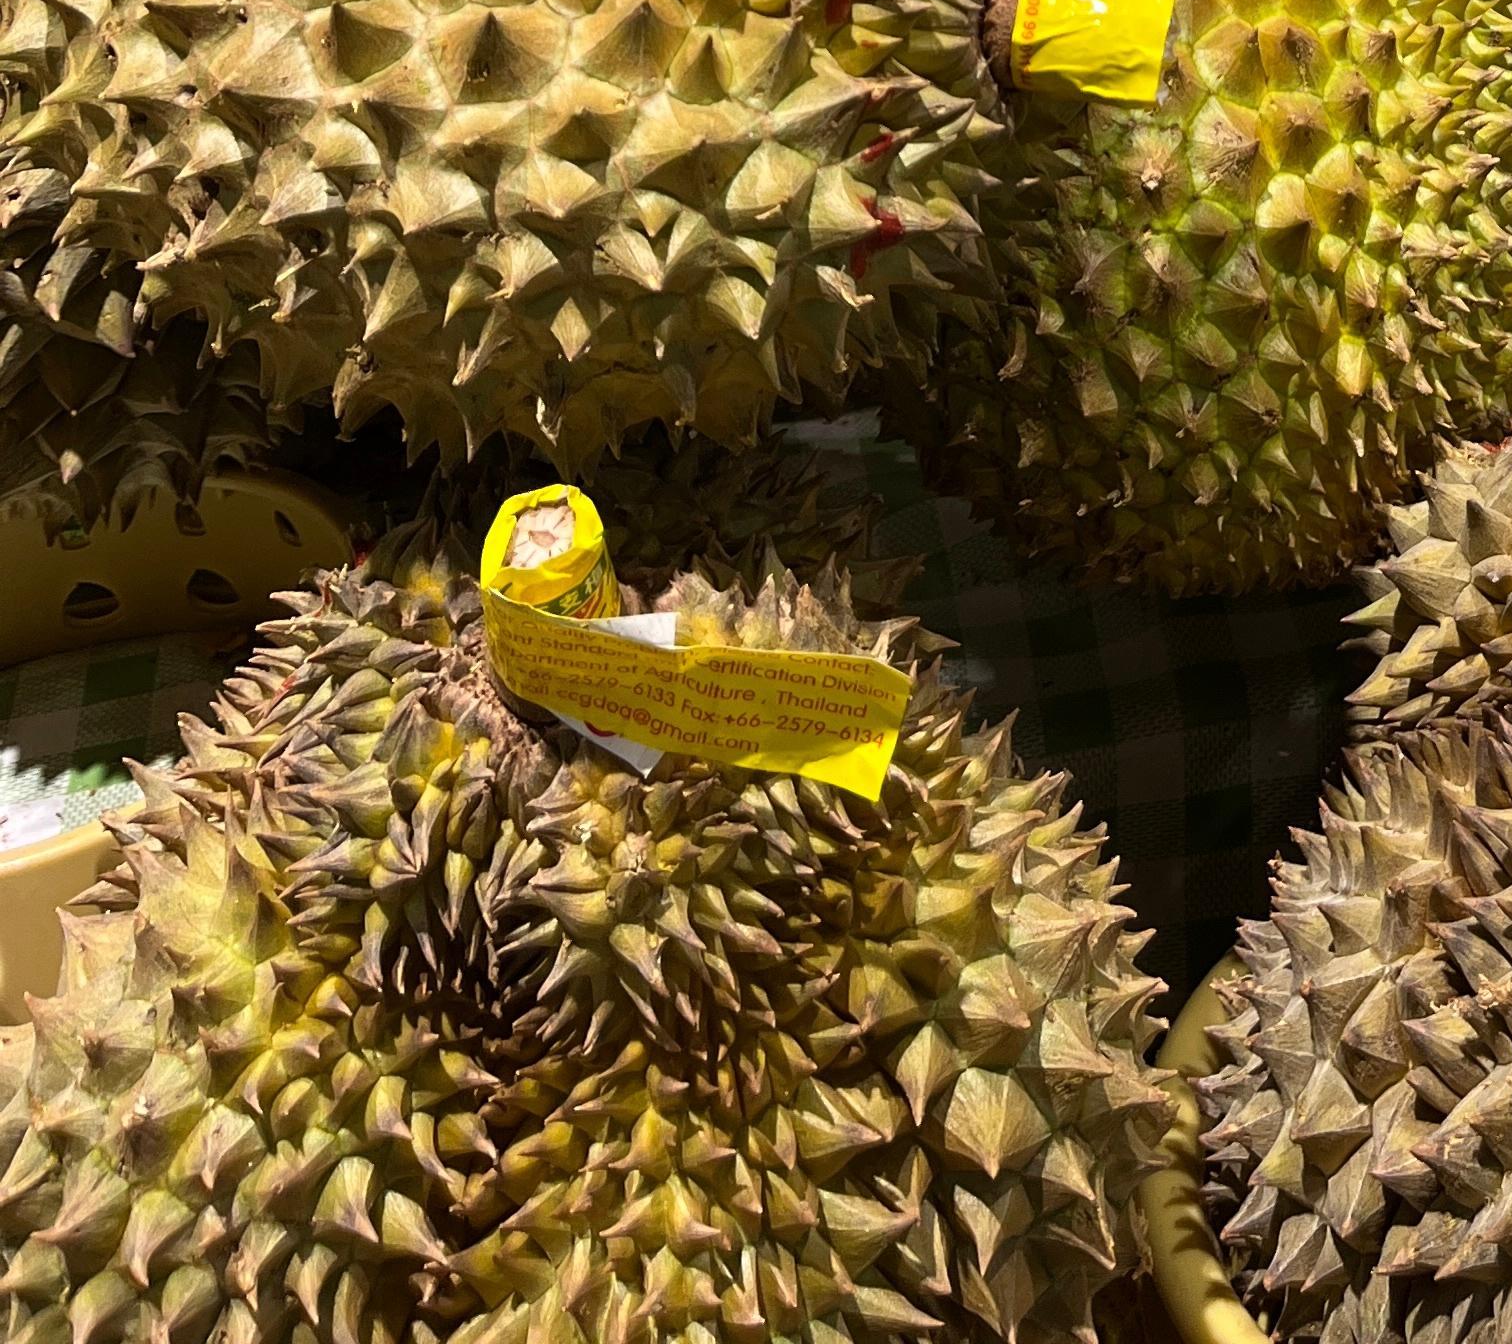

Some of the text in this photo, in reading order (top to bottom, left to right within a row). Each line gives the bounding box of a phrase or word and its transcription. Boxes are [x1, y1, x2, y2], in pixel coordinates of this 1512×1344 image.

[821, 674, 897, 702] Division
[775, 689, 868, 719] Thailand
[724, 712, 886, 750] +66-2579-6134
